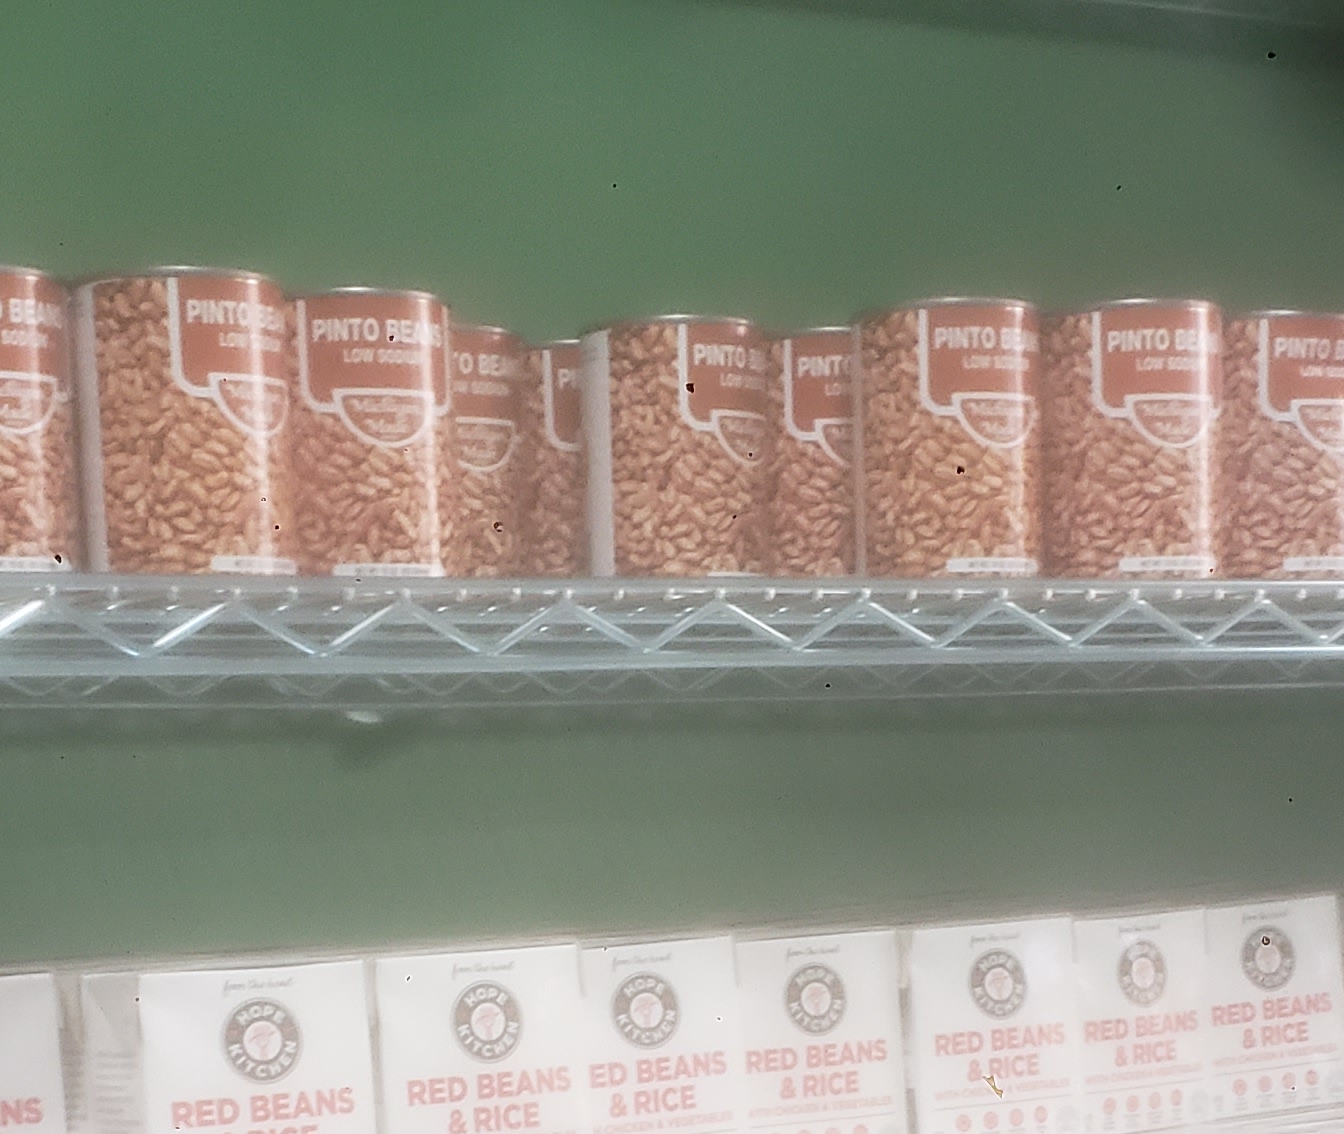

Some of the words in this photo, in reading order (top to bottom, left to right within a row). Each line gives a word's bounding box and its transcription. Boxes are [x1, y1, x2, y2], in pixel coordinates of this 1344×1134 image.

[186, 299, 248, 327] PINTO
[312, 318, 380, 342] PINTO
[935, 326, 997, 350] PINTO
[1108, 328, 1171, 352] PINTO
[693, 344, 746, 369] PINTO
[1274, 337, 1331, 359] PINTO
[236, 1004, 287, 1025] HOPE
[1213, 1003, 1258, 1027] RED
[1262, 993, 1333, 1022] BEANS
[1262, 1021, 1308, 1046] RICE
[228, 1040, 297, 1078] KITCHEN
[407, 1077, 470, 1108] RED
[478, 1068, 571, 1101] BEANS
[173, 1099, 241, 1130] RED
[251, 1087, 356, 1125] BEANS
[475, 1102, 539, 1132] RICE
